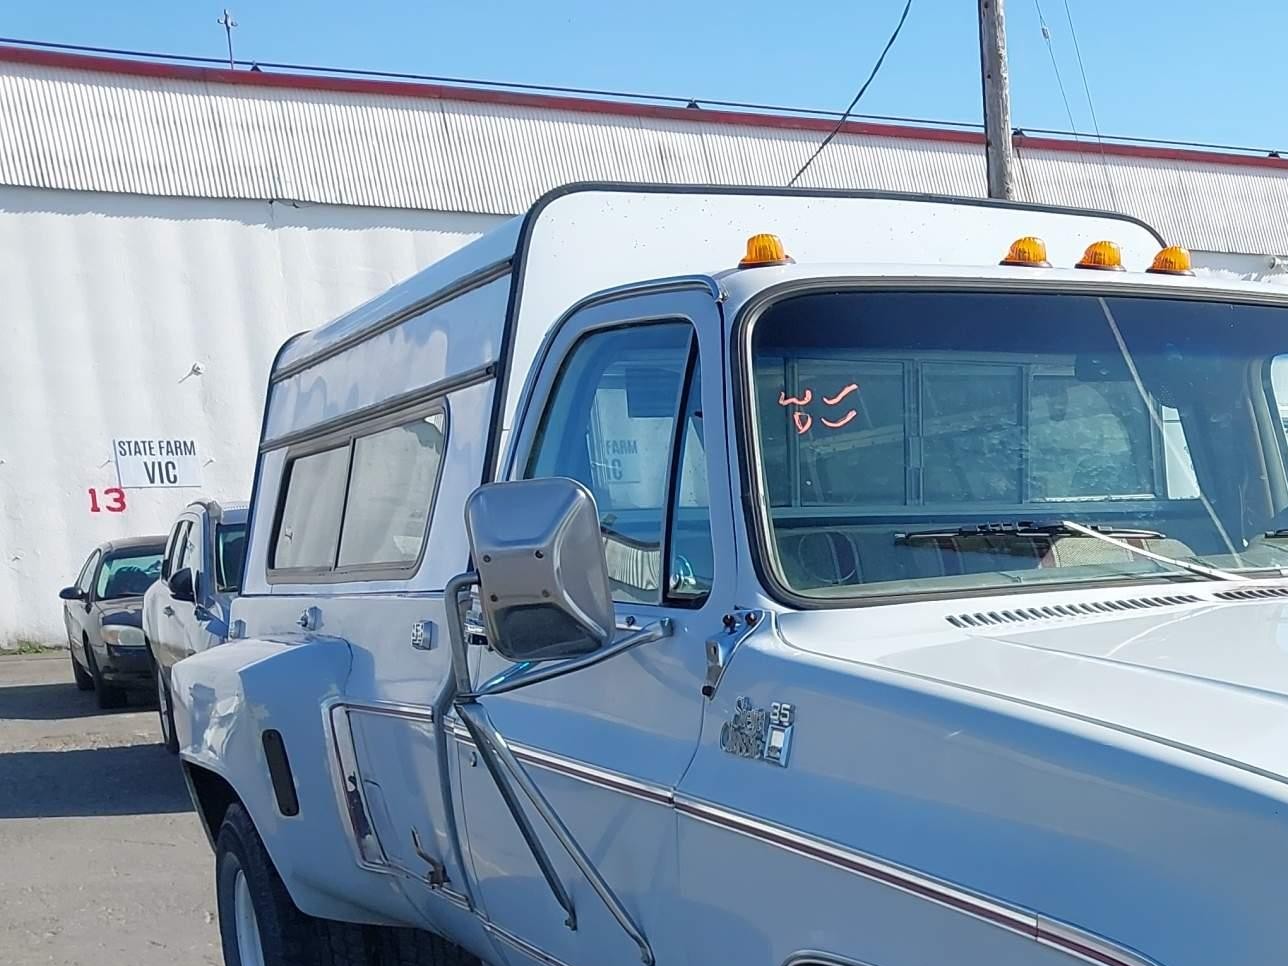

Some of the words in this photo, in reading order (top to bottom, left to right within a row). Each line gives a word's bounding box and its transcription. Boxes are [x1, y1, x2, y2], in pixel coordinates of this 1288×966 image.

[118, 440, 156, 456] STATE
[159, 440, 196, 456] FARM
[143, 461, 178, 484] VIC
[88, 488, 127, 512] 13
